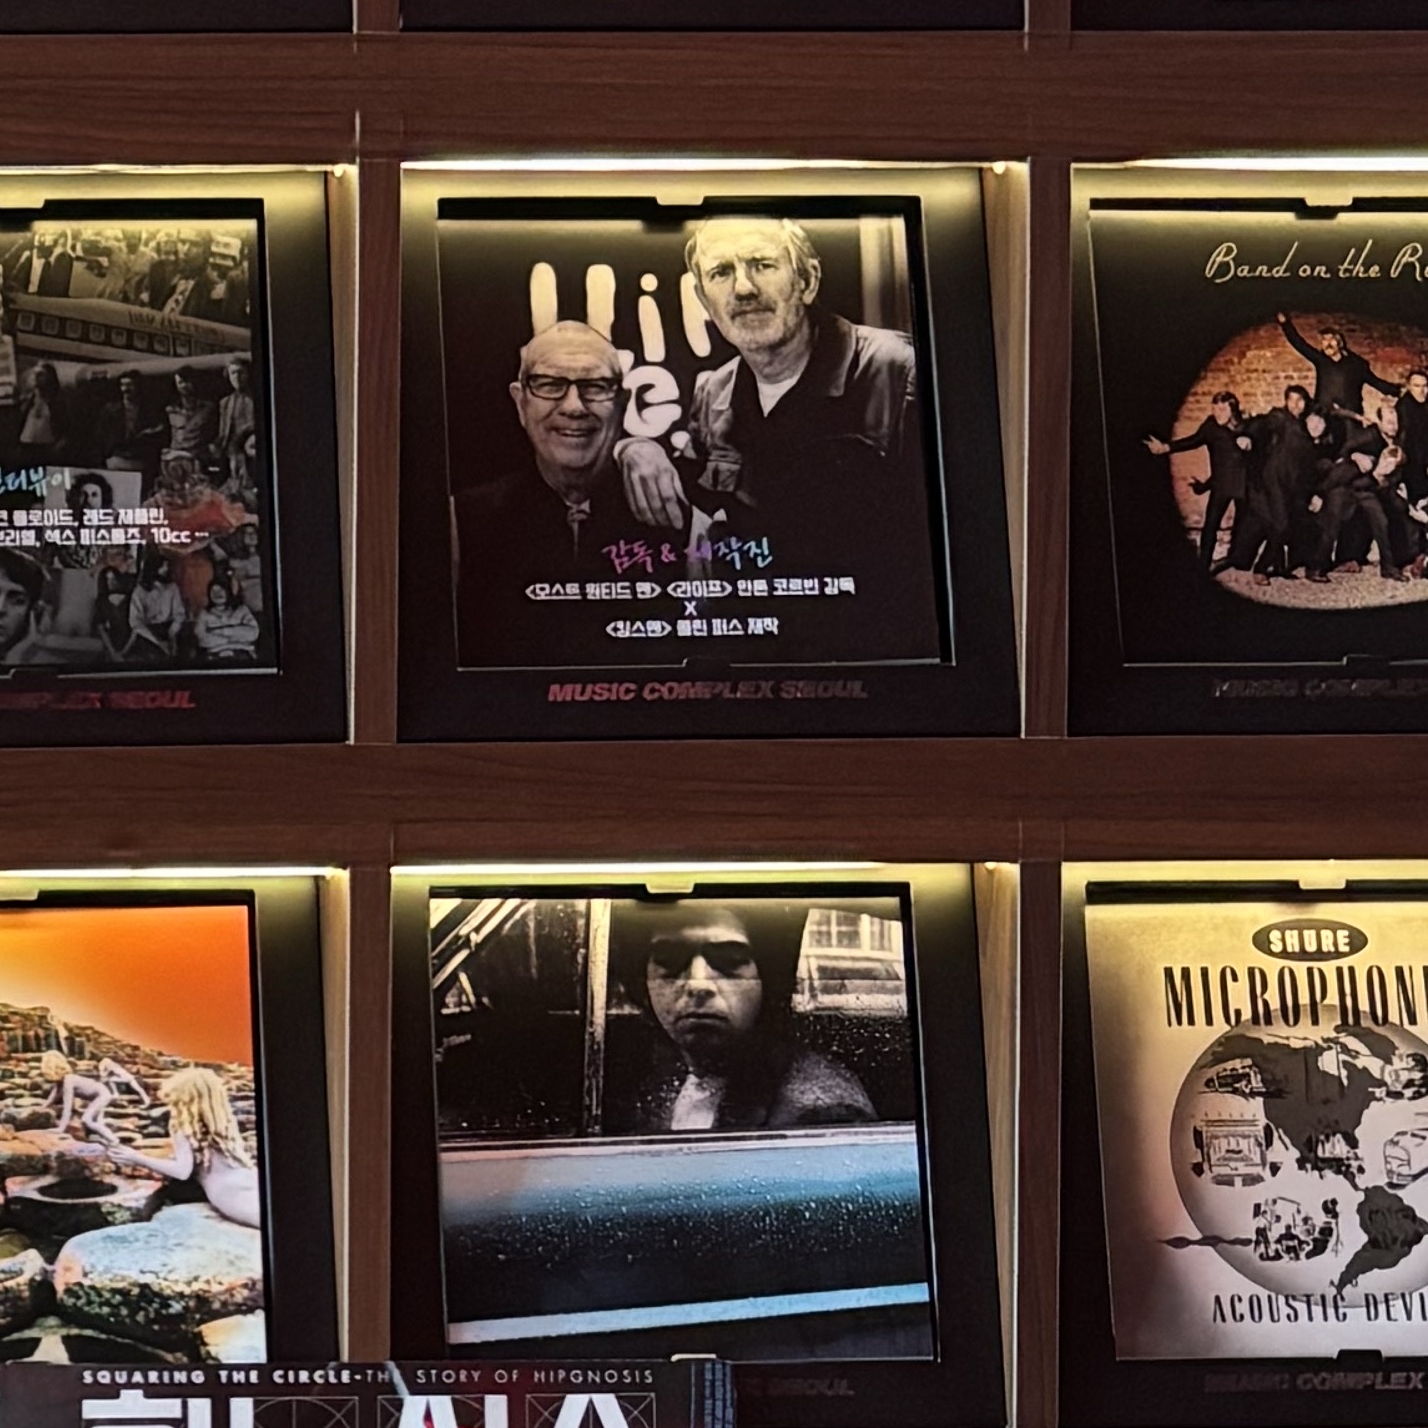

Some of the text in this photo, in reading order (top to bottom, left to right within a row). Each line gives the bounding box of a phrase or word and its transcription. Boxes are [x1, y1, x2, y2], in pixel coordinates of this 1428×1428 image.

[1205, 241, 1298, 284] Band
[1299, 261, 1331, 279] on
[1338, 239, 1382, 279] the
[151, 528, 191, 544] 10cc
[661, 543, 677, 563] &
[548, 684, 637, 702] MUSIC
[643, 682, 775, 701] COMPLEX
[1269, 930, 1351, 952] SHURE
[1213, 1293, 1348, 1323] ACOUSTIC
[83, 1370, 205, 1385] SQUARING
[219, 1370, 260, 1384] THE
[416, 1369, 481, 1384] STORY
[495, 1369, 517, 1383] OF
[534, 1369, 654, 1384] HIPGNOSIS
[1297, 1372, 1425, 1390] COMPLEX
